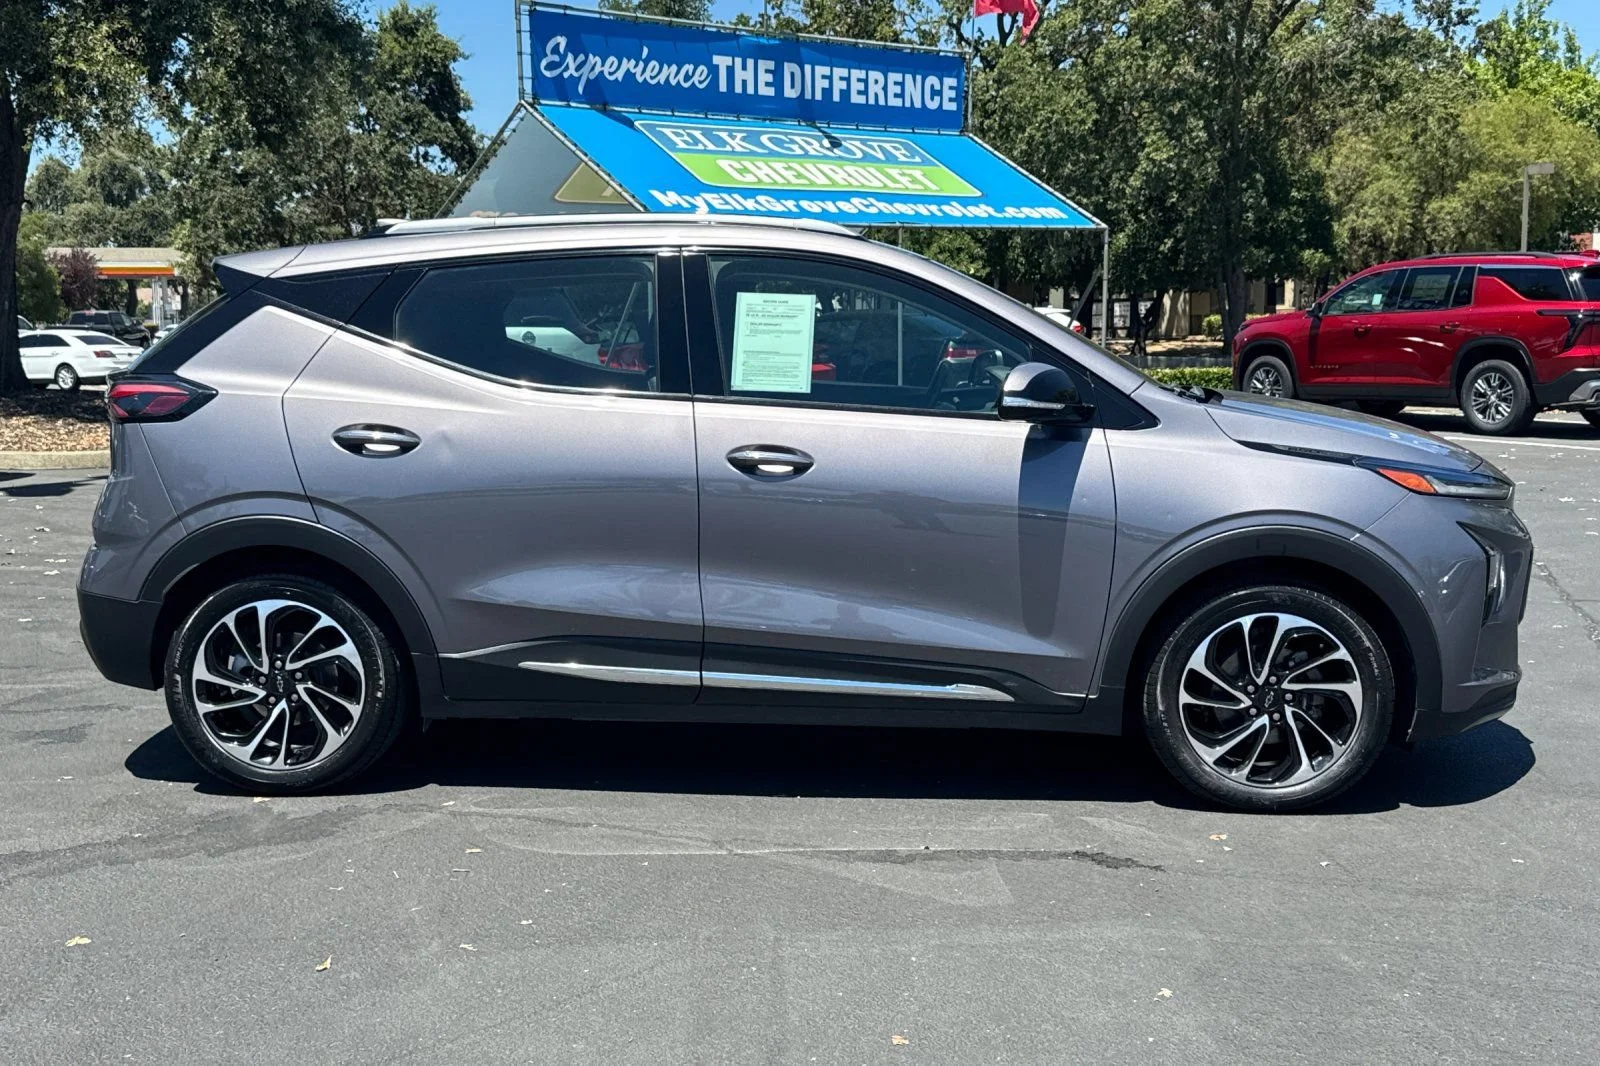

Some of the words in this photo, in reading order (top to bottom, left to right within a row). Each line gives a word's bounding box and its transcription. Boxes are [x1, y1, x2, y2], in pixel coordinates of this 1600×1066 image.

[540, 35, 712, 95] Experience
[713, 54, 775, 97] THE
[783, 61, 958, 111] DIFFERENCE
[656, 127, 769, 153] ELK
[760, 133, 922, 163] GROVE
[715, 158, 941, 191] CHEVROLET
[648, 189, 1069, 219] MyElkGroveChevrolet.com
